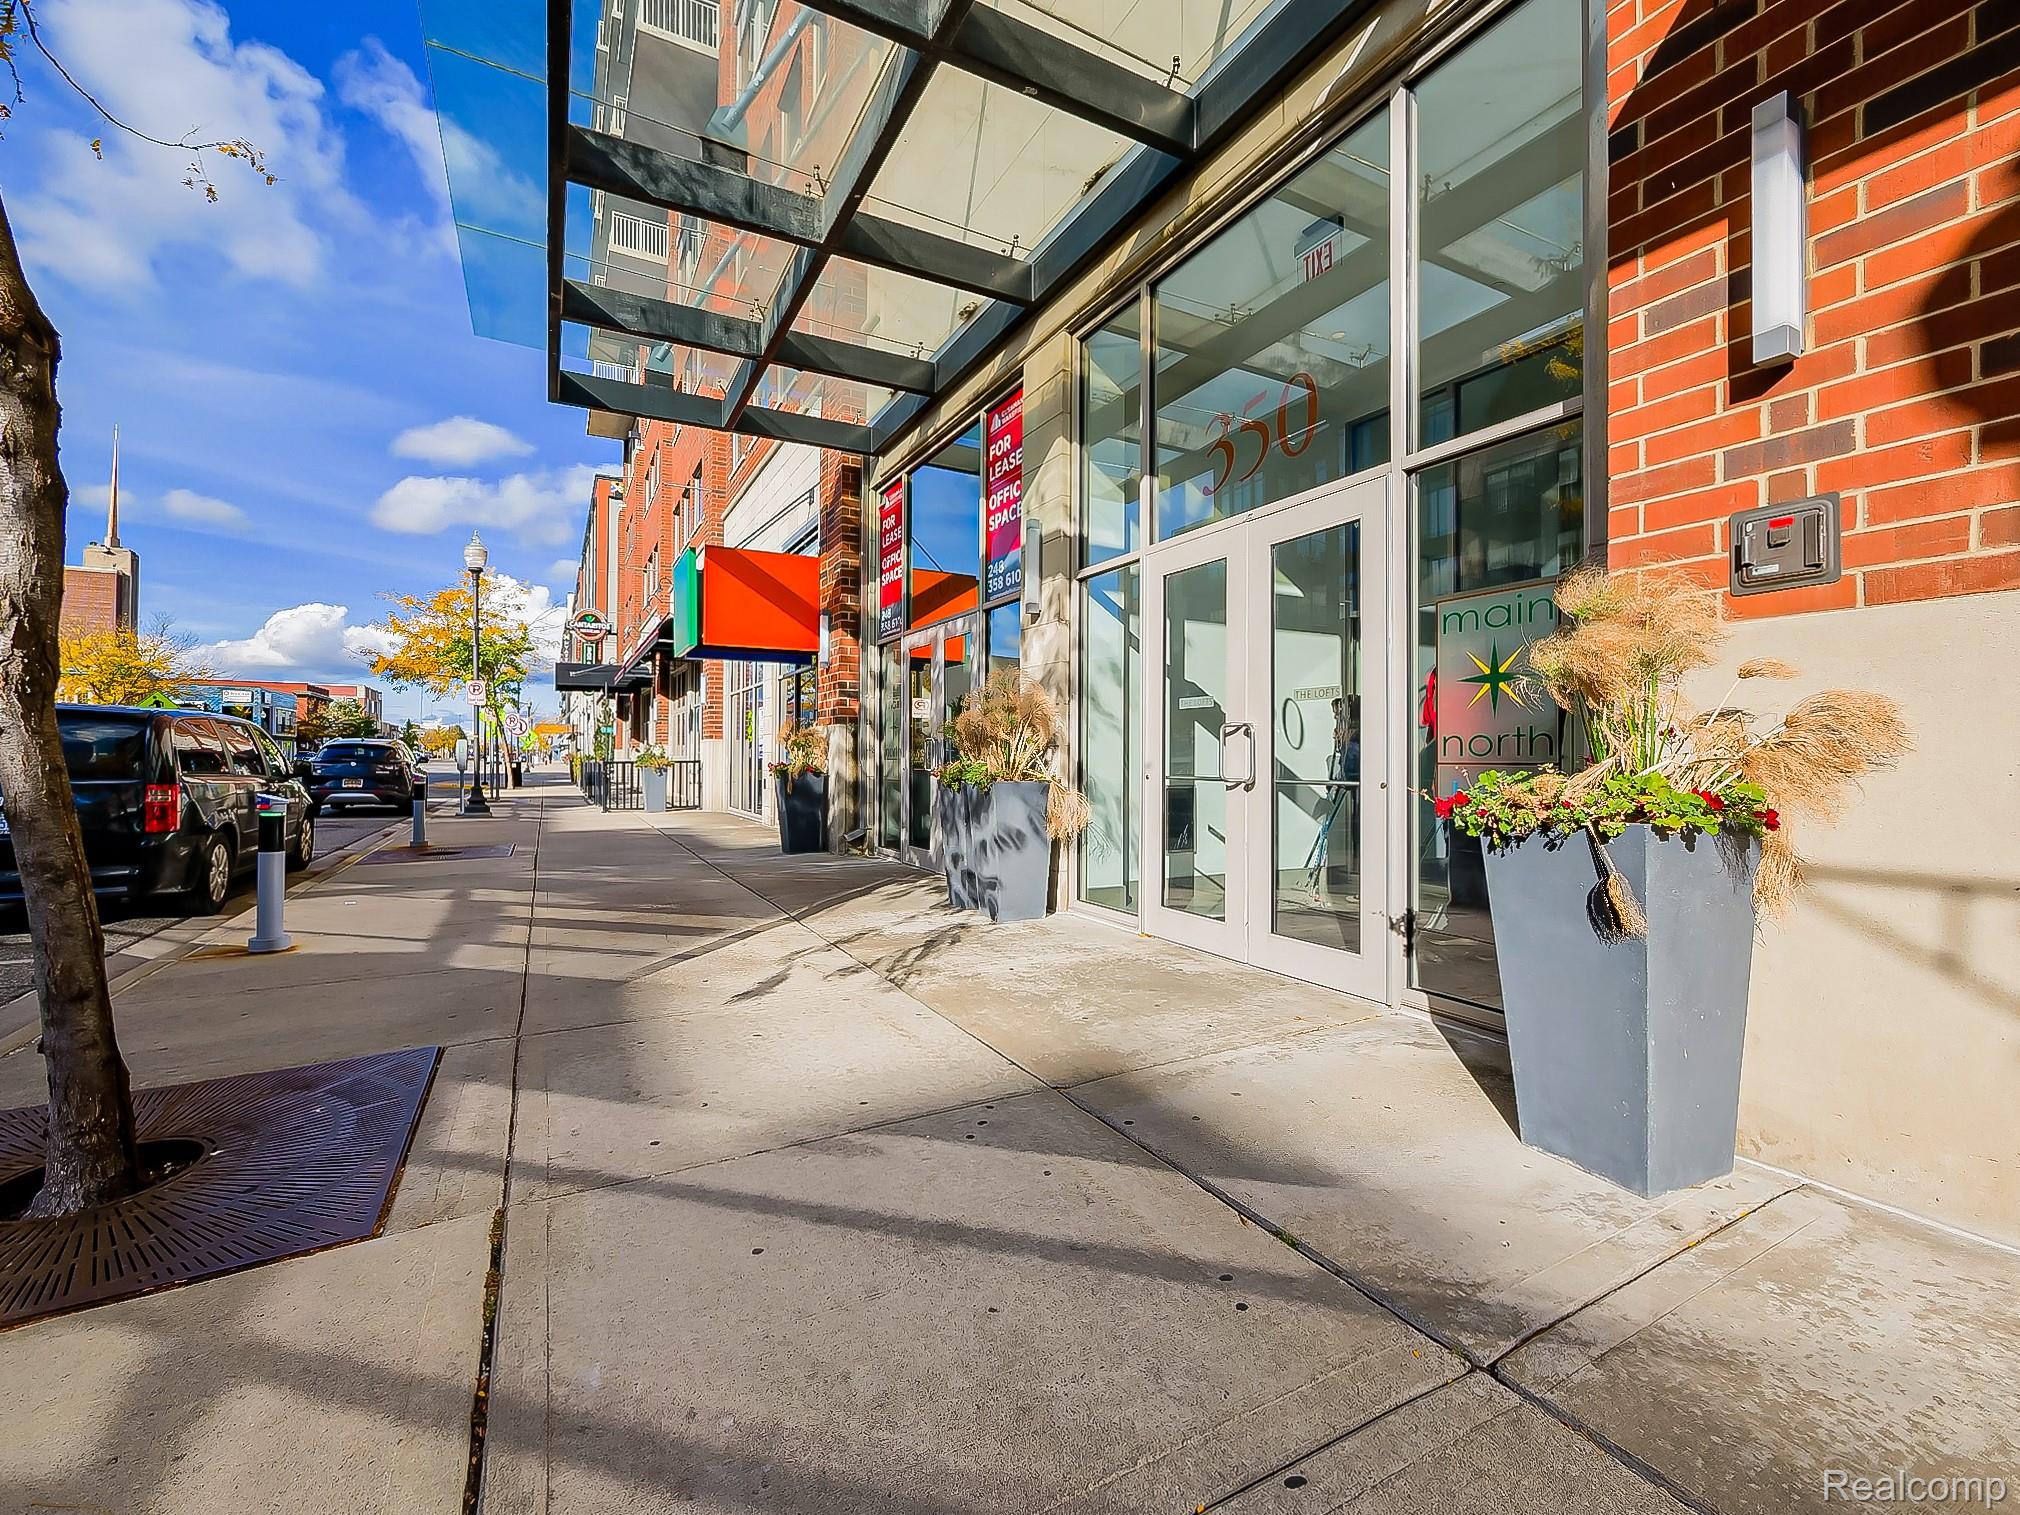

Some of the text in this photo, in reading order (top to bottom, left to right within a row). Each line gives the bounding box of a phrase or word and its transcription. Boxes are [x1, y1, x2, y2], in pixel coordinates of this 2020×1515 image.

[1202, 371, 1318, 496] 350
[989, 434, 1012, 462] FOR
[989, 447, 1023, 482] LEASE
[882, 514, 896, 533] FOR
[882, 526, 902, 549] LEASE
[881, 565, 903, 587] SPACE
[987, 559, 1005, 578] 248
[987, 575, 1004, 593] 358
[1442, 593, 1554, 635] main
[1181, 699, 1193, 708] THE
[1295, 687, 1341, 699] THE LOFTS
[1442, 725, 1554, 758] north
